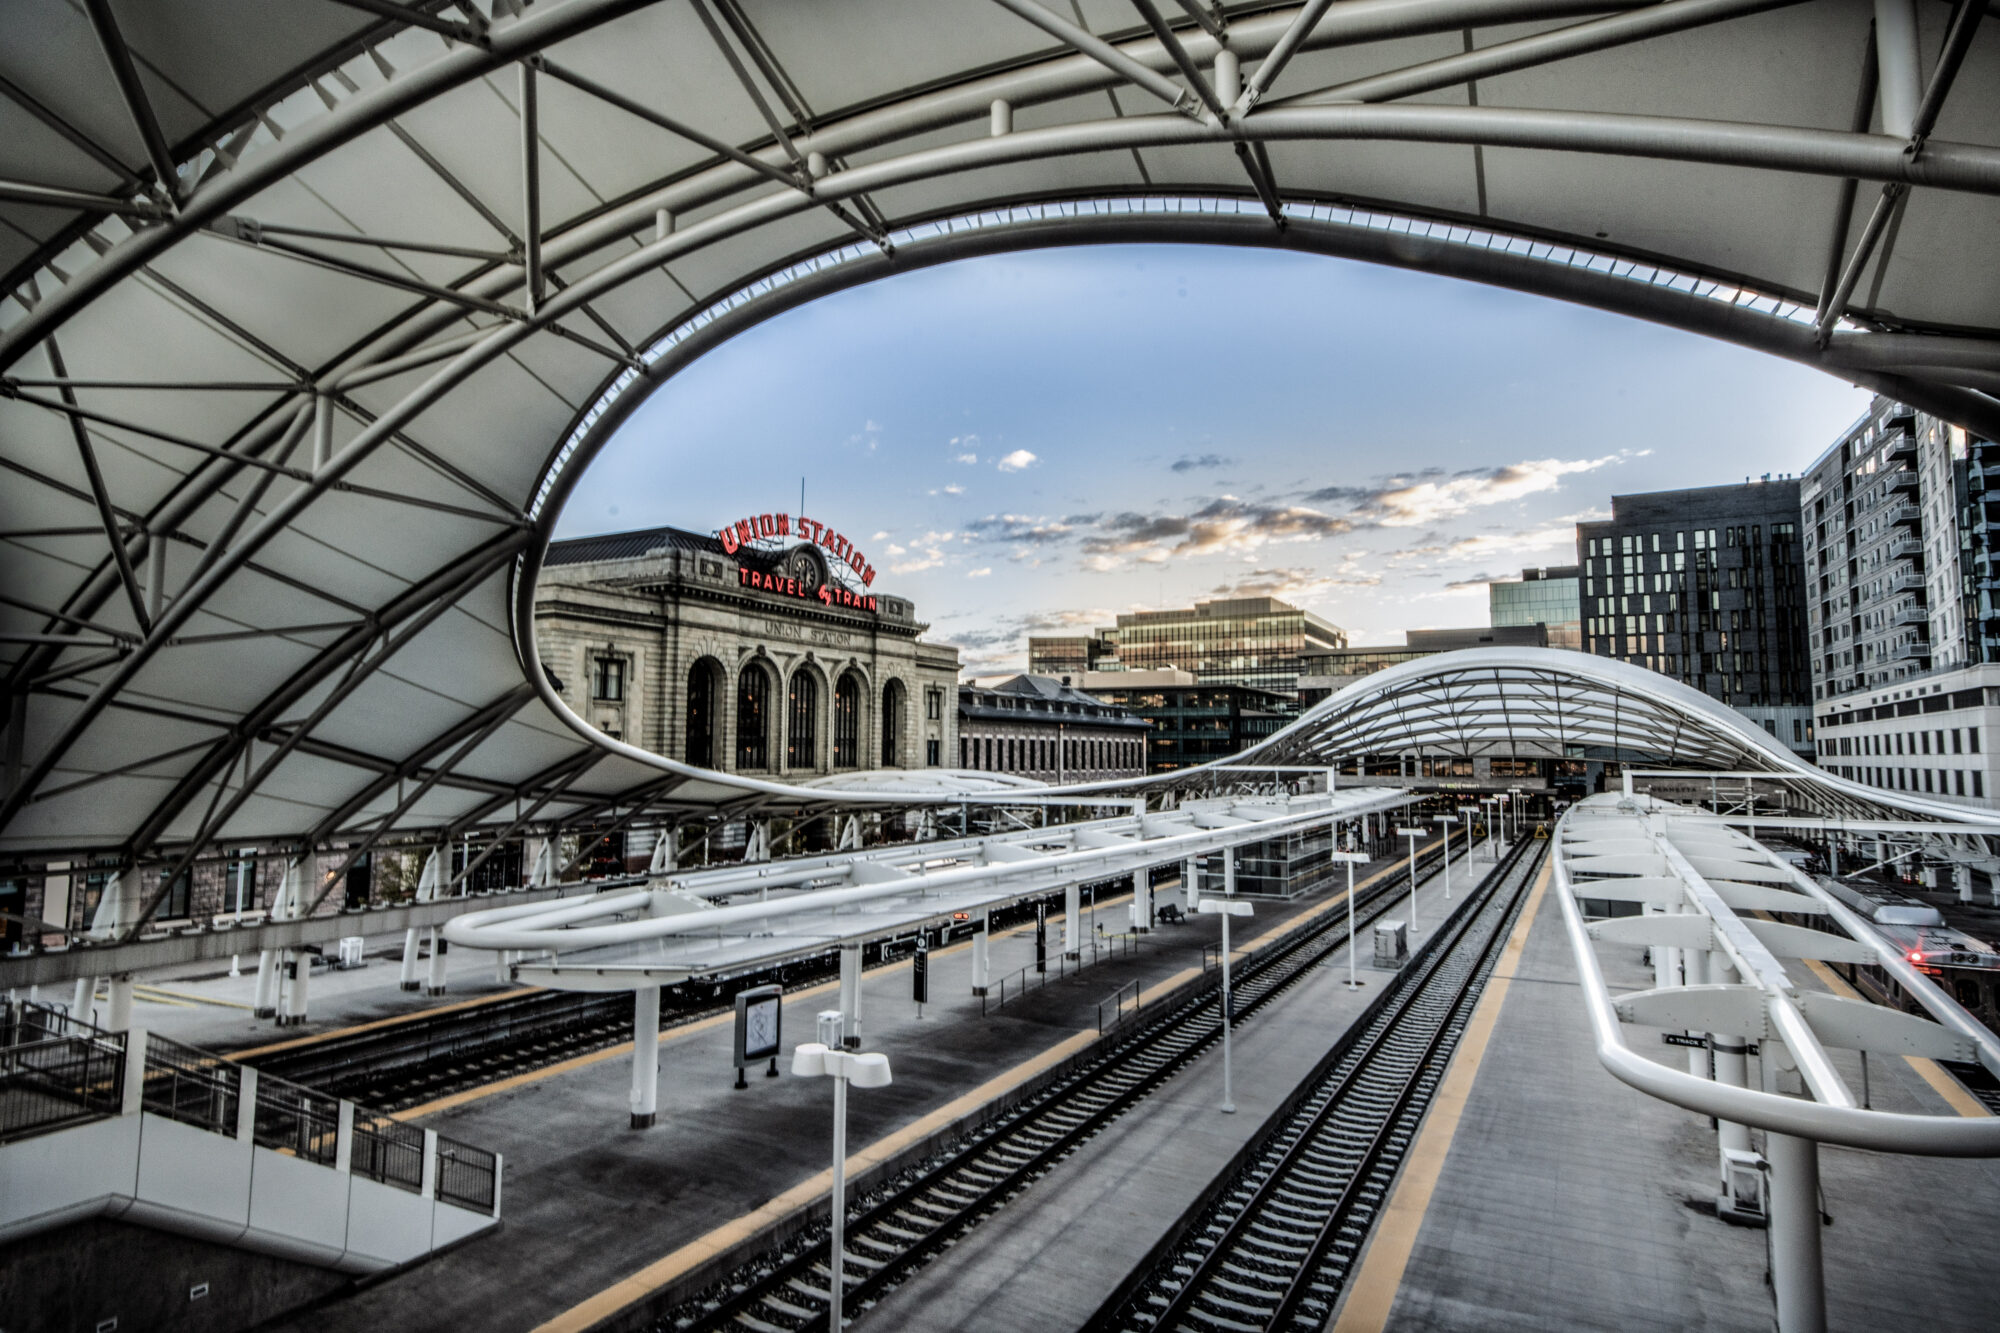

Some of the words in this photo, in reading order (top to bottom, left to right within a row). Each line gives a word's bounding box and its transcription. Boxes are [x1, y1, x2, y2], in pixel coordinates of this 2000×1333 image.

[719, 513, 790, 554] UNION
[798, 516, 877, 588] STATION
[740, 567, 805, 598] TRAVEL
[818, 583, 832, 607] by
[834, 588, 877, 611] TRAIN
[764, 620, 801, 639] UNION
[810, 630, 851, 646] STATION
[1675, 1037, 1699, 1047] TRACK
